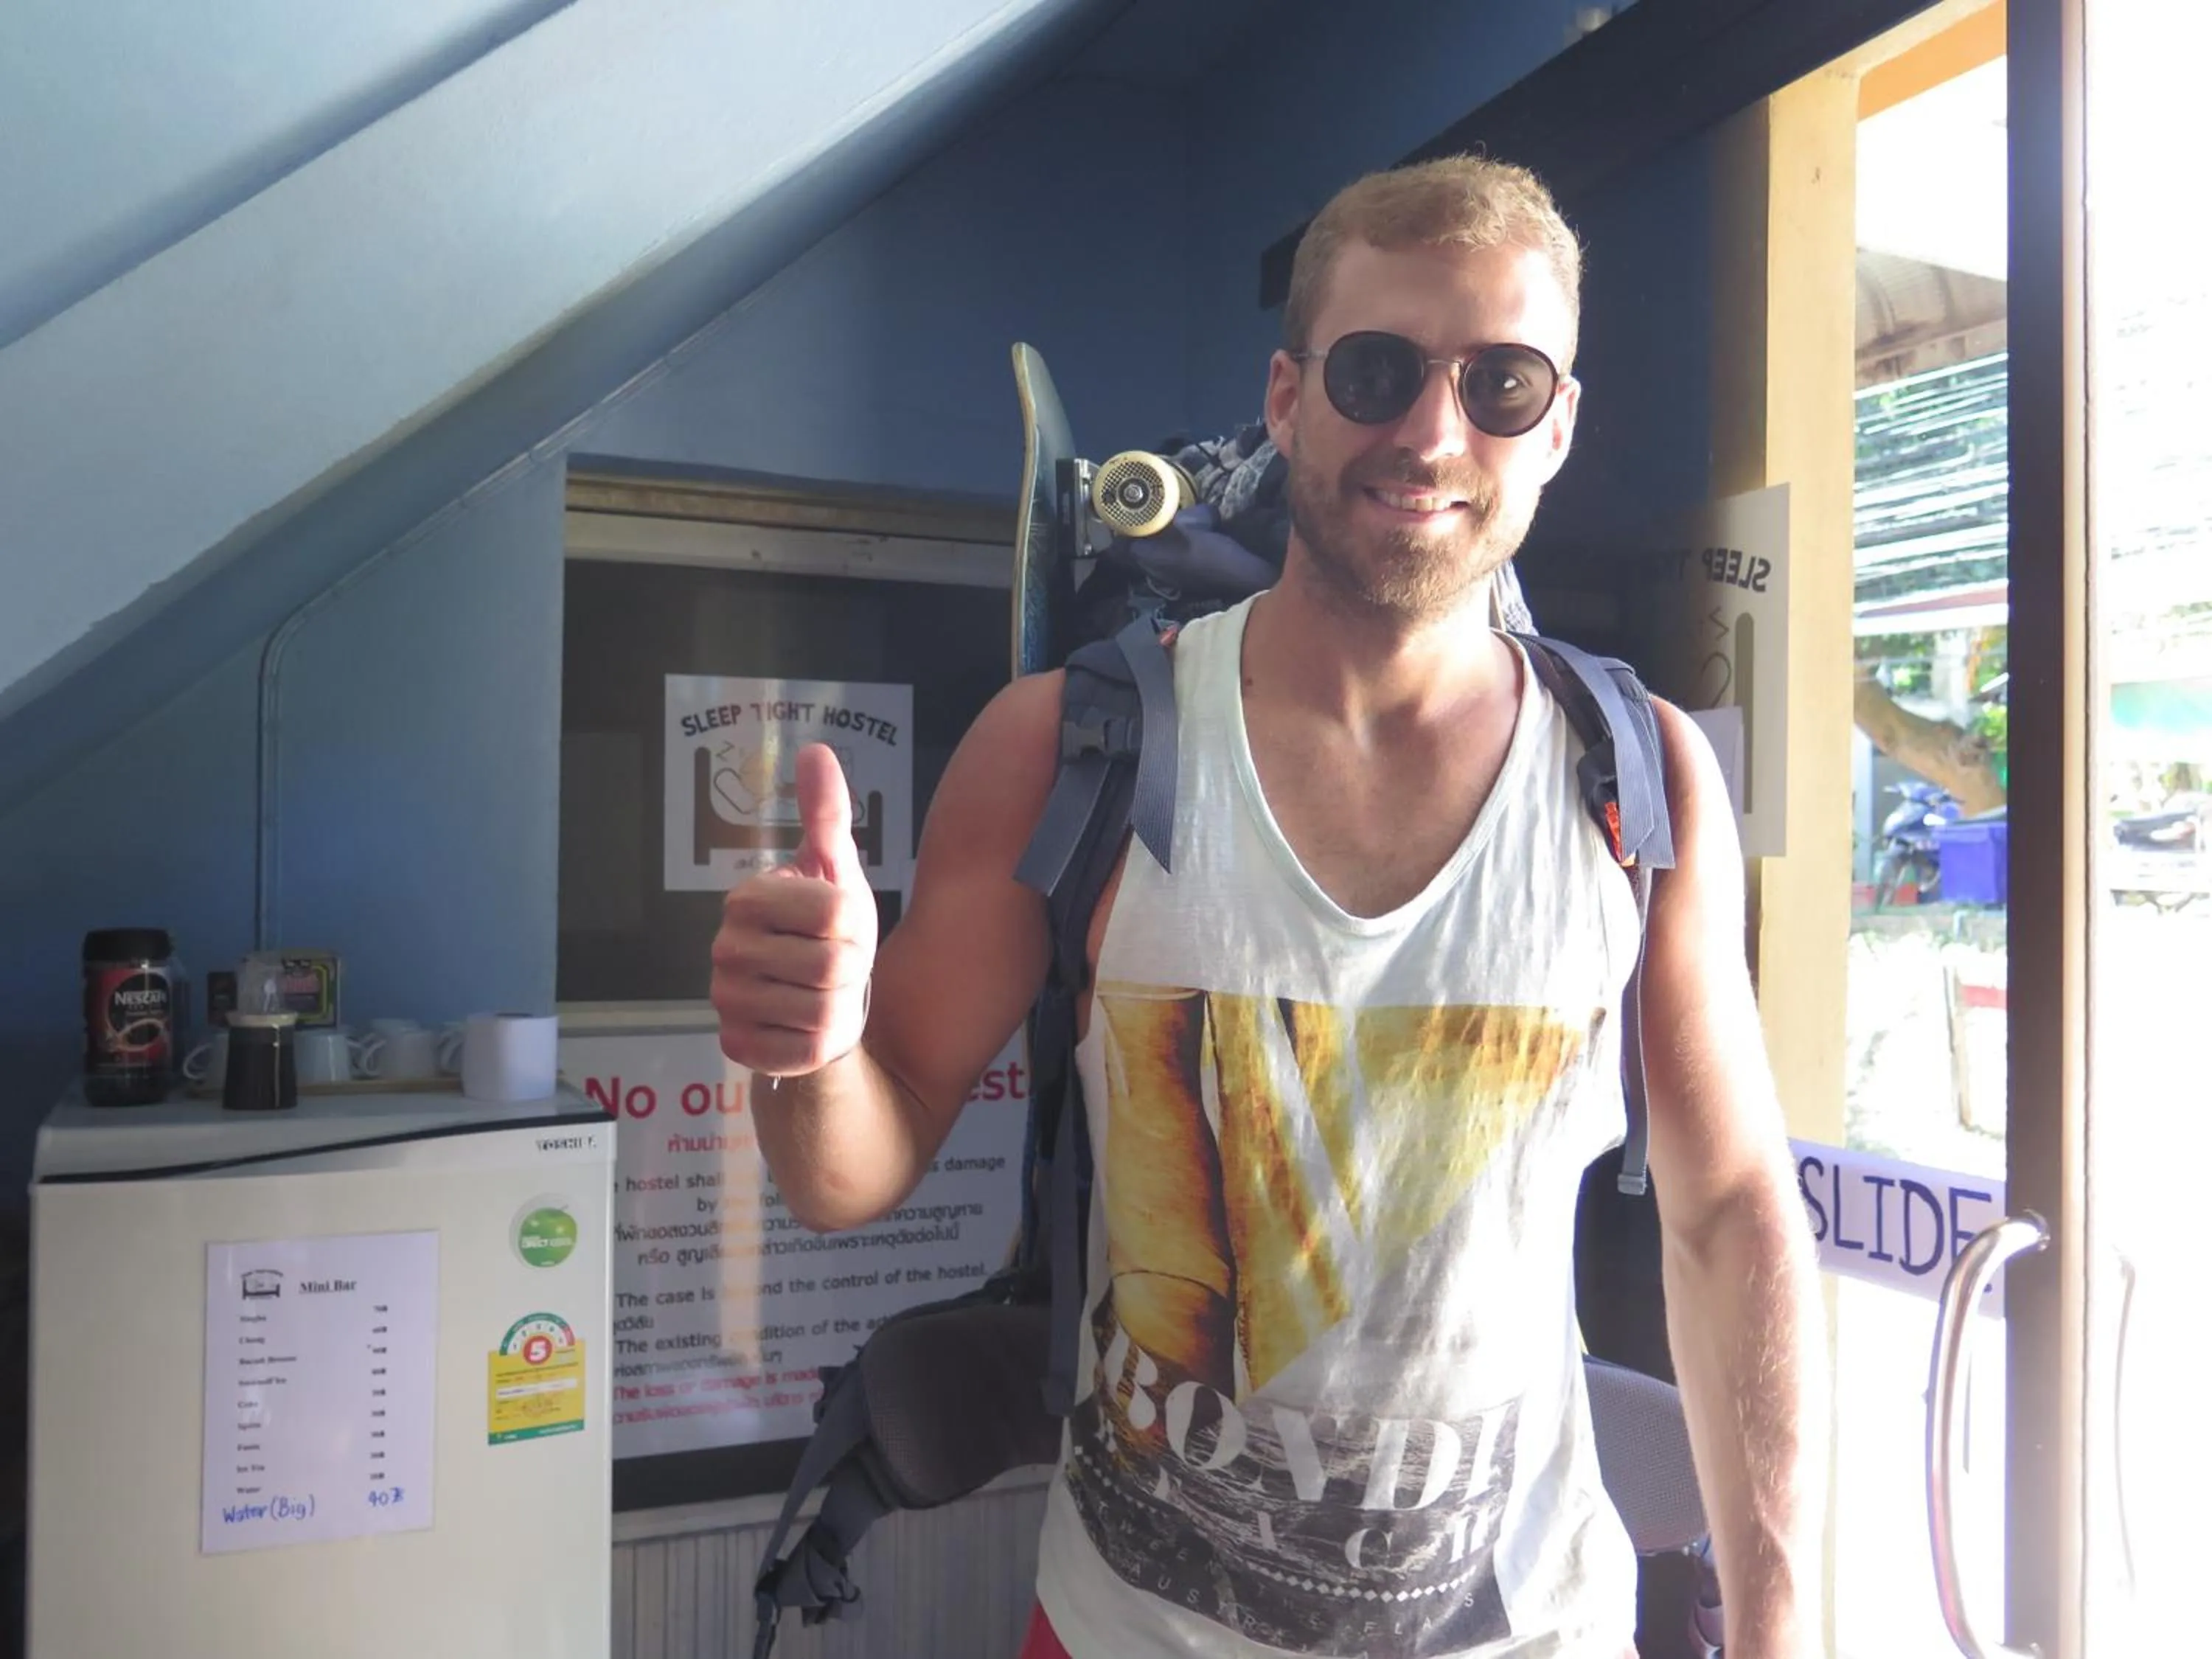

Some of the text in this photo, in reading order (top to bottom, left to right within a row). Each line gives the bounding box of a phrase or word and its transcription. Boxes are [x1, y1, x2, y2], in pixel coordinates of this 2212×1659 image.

[681, 701, 900, 747] SLEEP TIGHT HOSTEL
[626, 1174, 680, 1192] hostel
[944, 1155, 1006, 1174] damage
[697, 1197, 717, 1214] by
[1798, 1155, 1993, 1293] SLIDE
[616, 1292, 649, 1308] The
[655, 1290, 695, 1306] case
[701, 1286, 715, 1301] is
[790, 1278, 815, 1293] the
[822, 1270, 879, 1291] control
[885, 1267, 902, 1285] of
[906, 1265, 932, 1283] the
[529, 1340, 547, 1361] 5
[616, 1339, 649, 1354] The
[655, 1332, 722, 1352] existing
[812, 1319, 830, 1336] of
[834, 1318, 860, 1334] the
[765, 1371, 779, 1385] is
